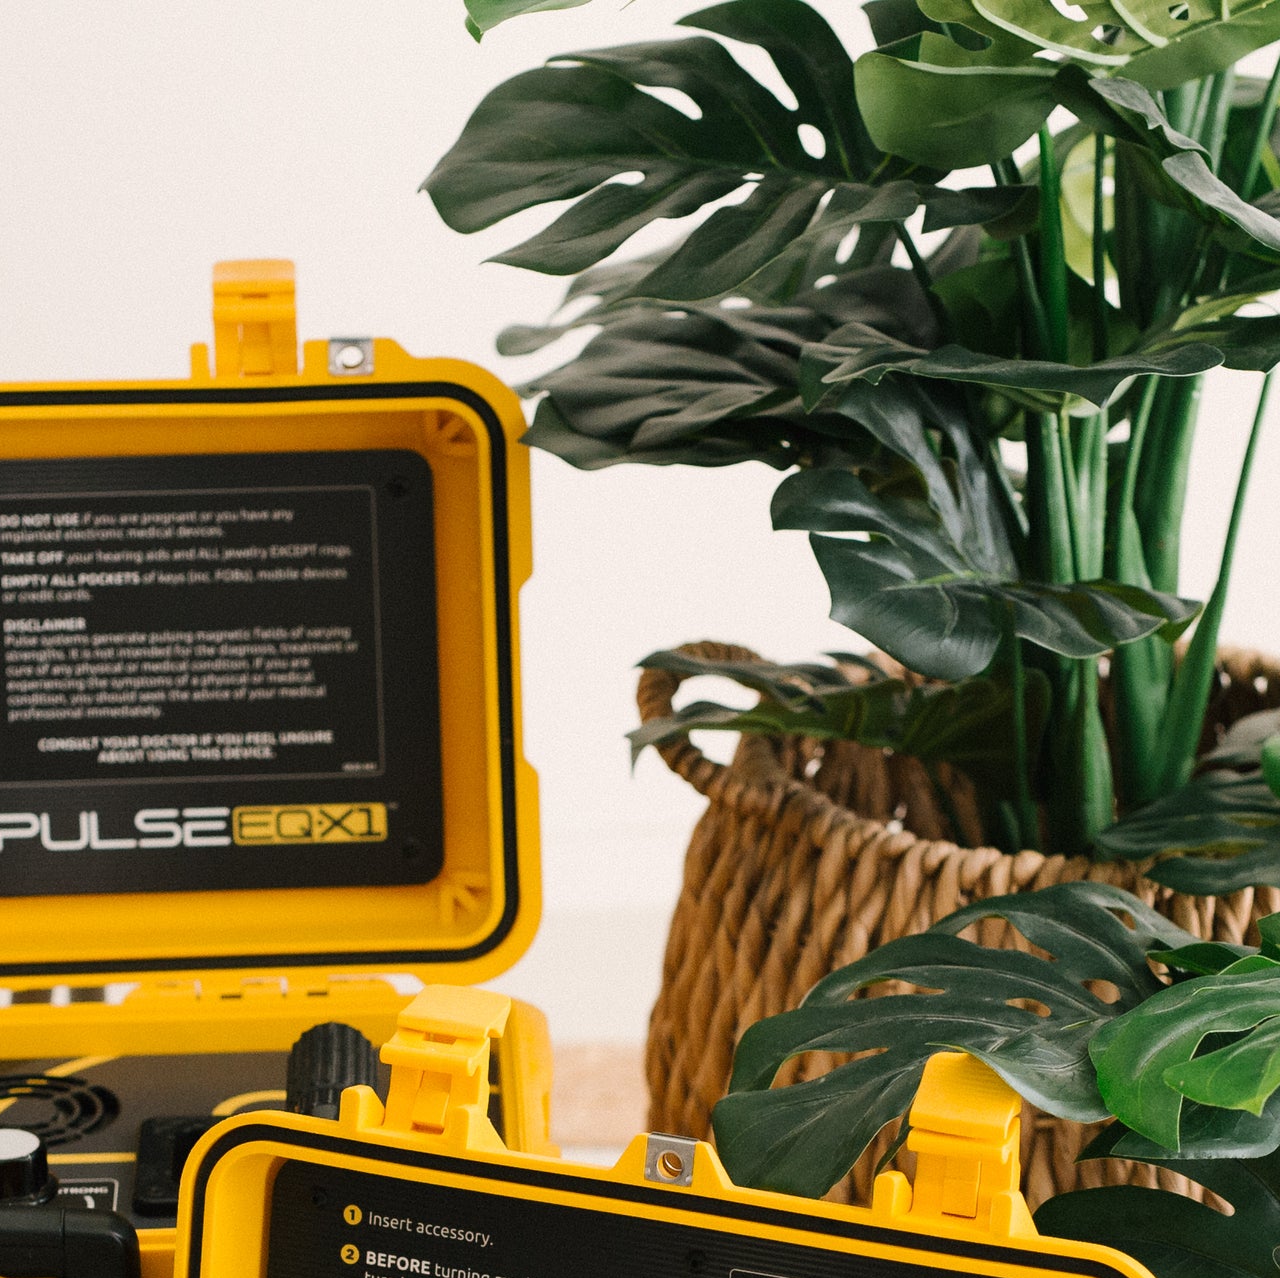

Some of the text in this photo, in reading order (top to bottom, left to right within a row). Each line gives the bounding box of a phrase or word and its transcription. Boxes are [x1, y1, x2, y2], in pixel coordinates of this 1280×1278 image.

[368, 1210, 412, 1232] Insert
[415, 1221, 493, 1247] accessory.
[365, 1250, 430, 1275] BEFORE
